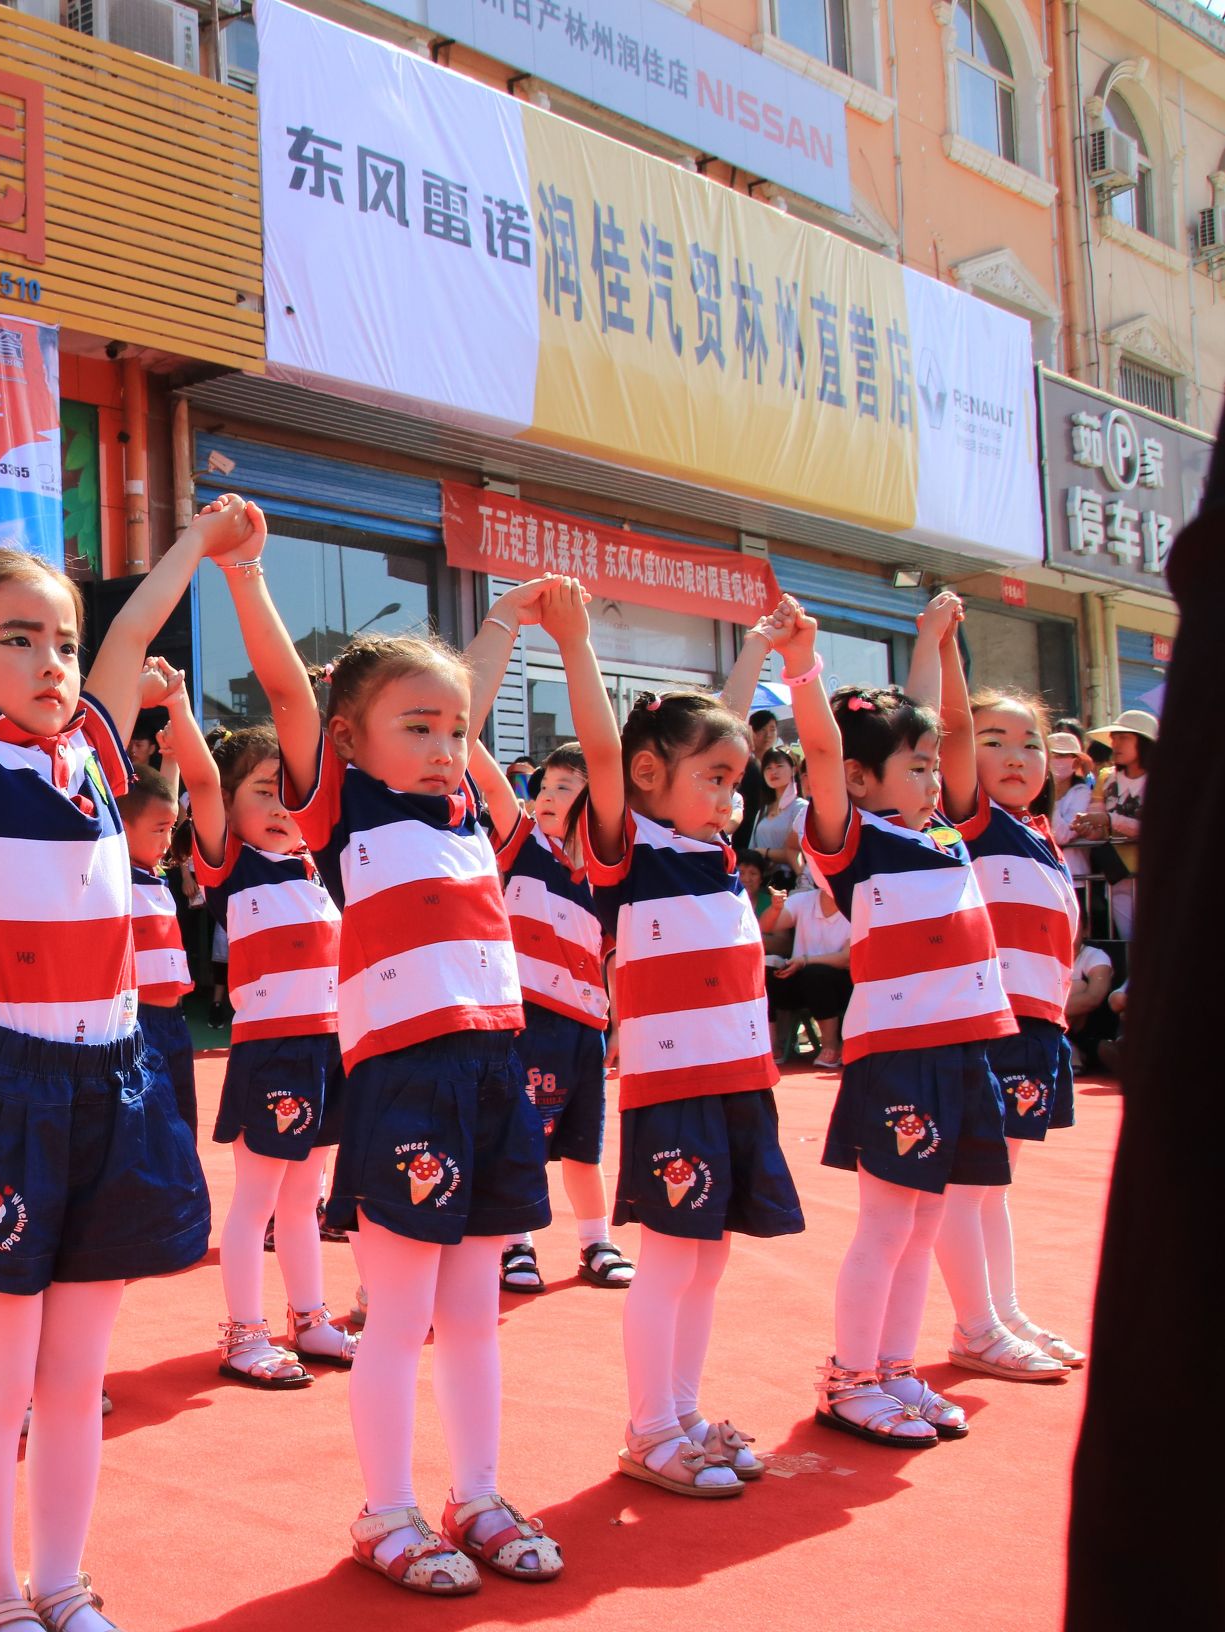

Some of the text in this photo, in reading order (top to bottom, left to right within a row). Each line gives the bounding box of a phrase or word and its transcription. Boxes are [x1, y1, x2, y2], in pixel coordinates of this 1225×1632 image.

[697, 69, 834, 168] NISSAN
[286, 126, 914, 434] 东风雷诺 润佳汽贸林州直营店
[953, 390, 1014, 428] RENAULT
[422, 895, 441, 906] WB
[16, 951, 36, 965] WB
[380, 968, 397, 982] WB
[255, 989, 267, 998] WB
[658, 1039, 674, 1050] WB
[527, 1067, 556, 1093] 68
[884, 1104, 916, 1115] sweet
[395, 1140, 429, 1156] sweet
[652, 1147, 682, 1163] sweet
